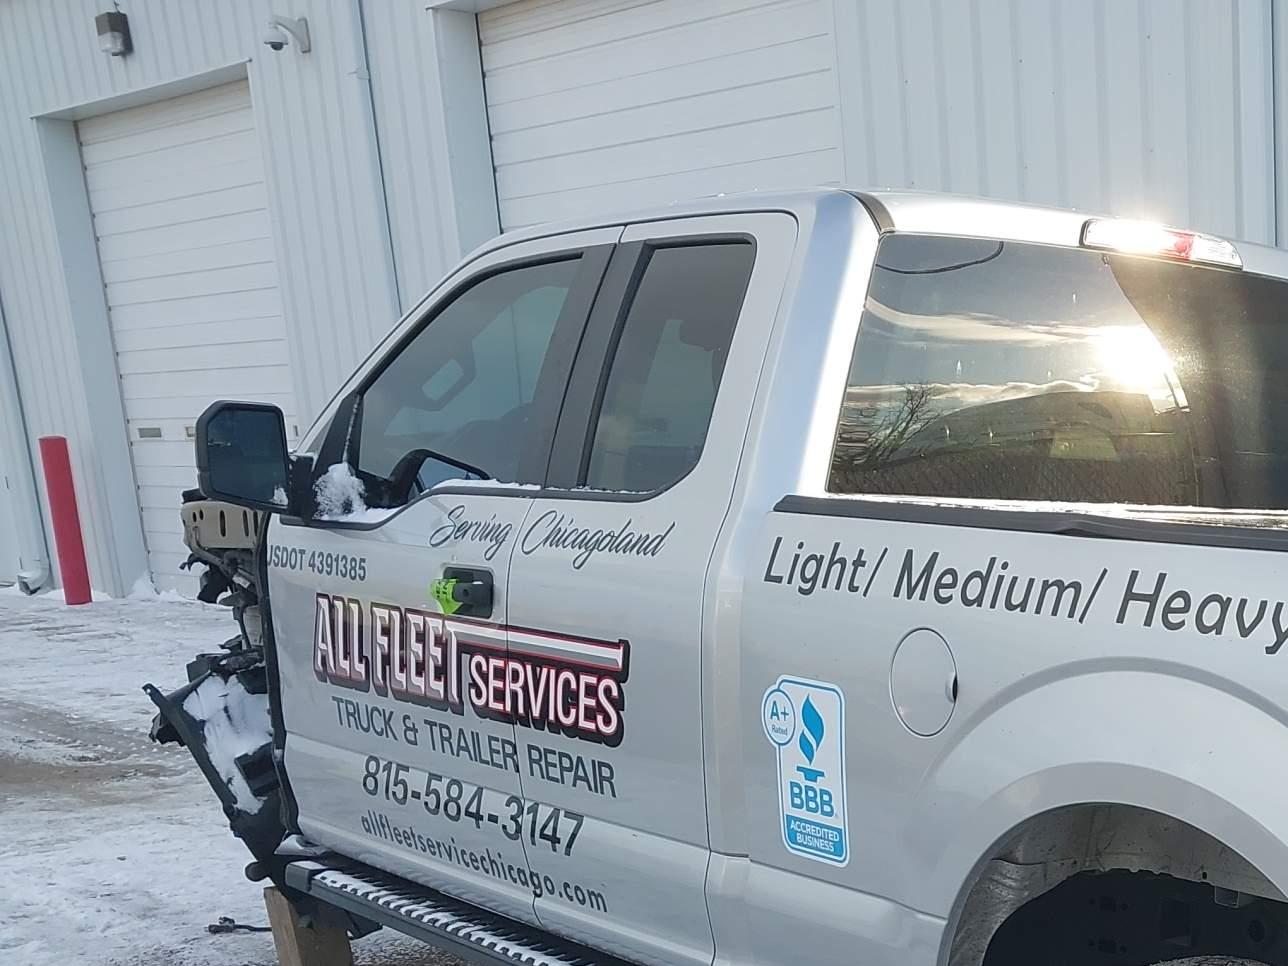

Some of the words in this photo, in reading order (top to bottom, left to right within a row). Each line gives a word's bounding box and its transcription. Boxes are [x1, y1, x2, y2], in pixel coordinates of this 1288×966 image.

[308, 550, 367, 581] 4391385
[429, 505, 513, 561] Serving
[521, 510, 676, 569] Chicagoland
[763, 536, 888, 597] Light/
[892, 548, 1108, 624] Medium/
[313, 593, 371, 687] ALL
[371, 602, 470, 716] FLEET
[469, 653, 622, 744] SERVICES
[769, 700, 790, 722] A+
[332, 696, 399, 741] TRUCK
[403, 714, 419, 746] &
[424, 719, 520, 774] TRAILER
[527, 744, 617, 799] REPAIR
[361, 755, 586, 858] 815-584-3147
[790, 780, 834, 818] BBB
[790, 819, 840, 843] ACCREDITED
[361, 810, 609, 914] allfleetservicechicago.com
[796, 834, 835, 853] BUSINESS
